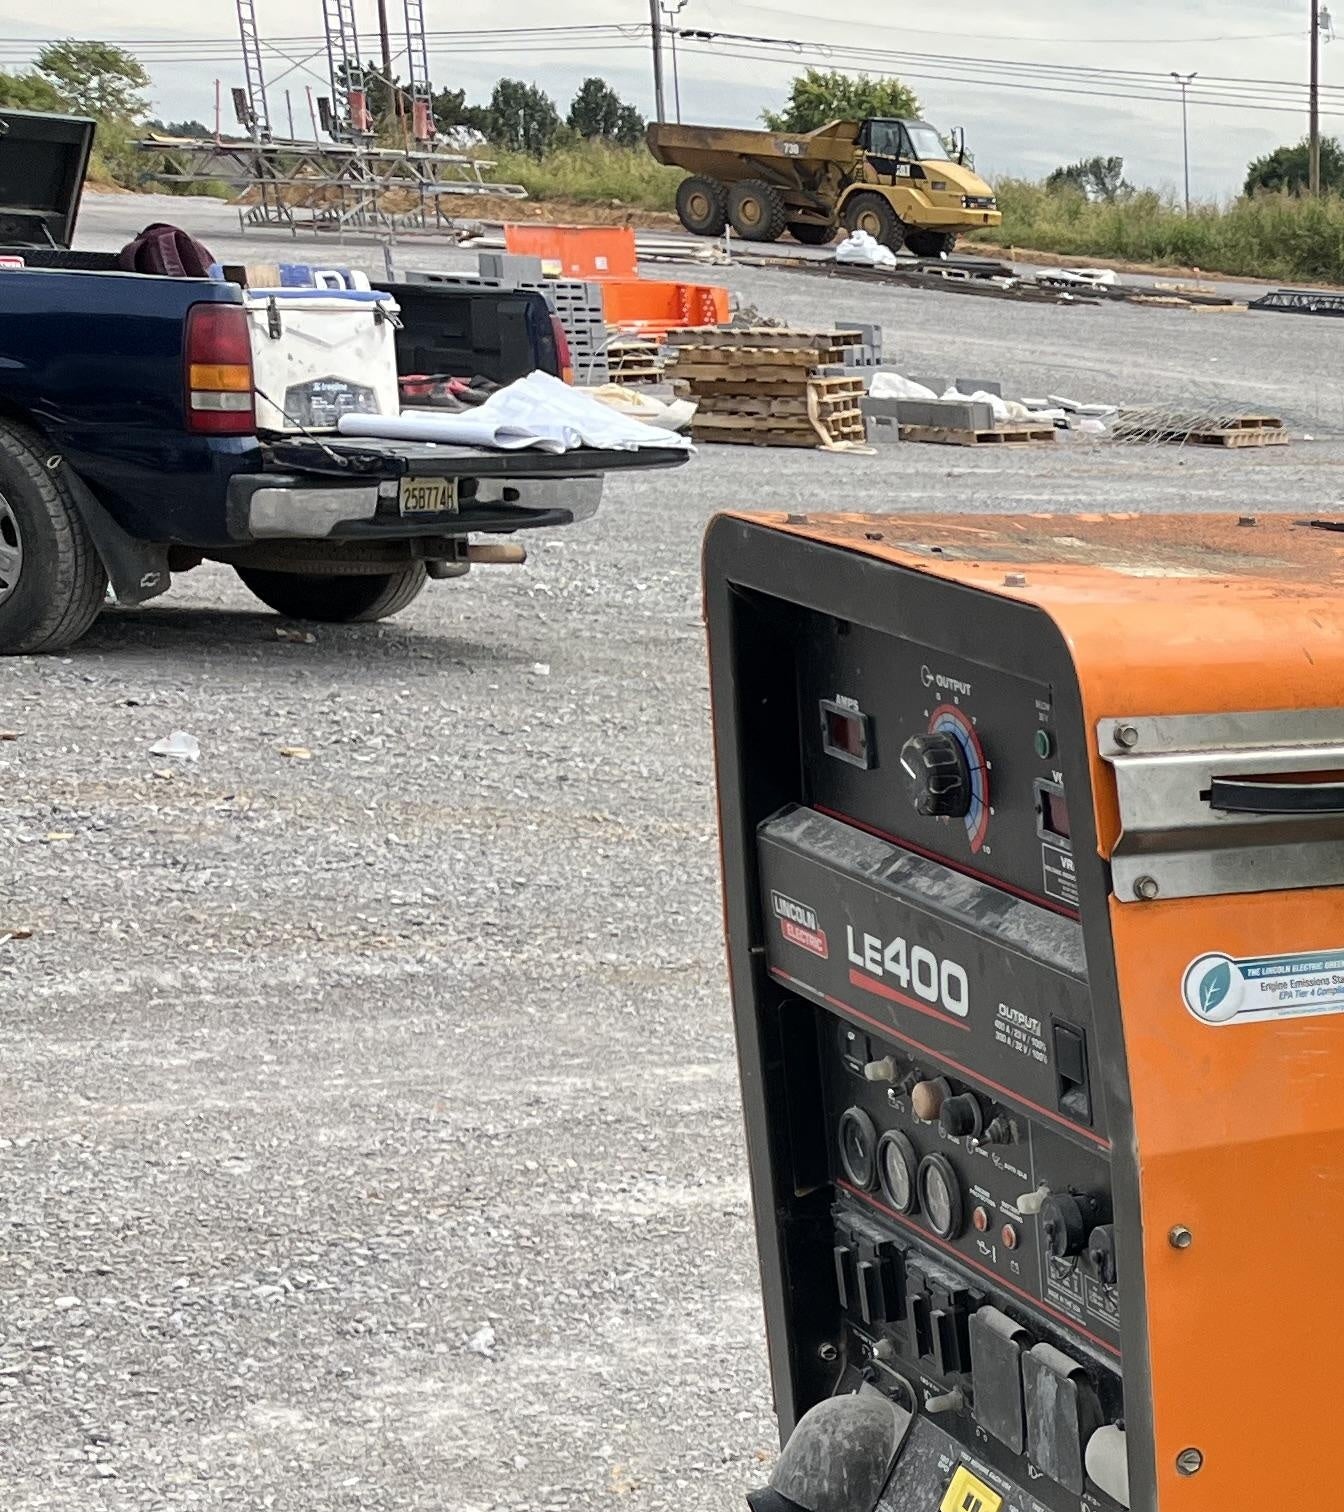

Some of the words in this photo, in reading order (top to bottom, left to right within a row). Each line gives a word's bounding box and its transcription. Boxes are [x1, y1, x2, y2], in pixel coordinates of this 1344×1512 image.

[936, 675, 972, 696] OUTPUT
[774, 895, 816, 930] LINCOLN
[787, 923, 823, 952] ELECTRIC
[846, 924, 969, 1017] LE400
[1247, 968, 1260, 977] THE
[1262, 965, 1291, 975] LINCOLN
[1292, 962, 1324, 973] ELECTRIC
[1260, 981, 1288, 992] Engine
[1290, 978, 1330, 989] Emissions
[1279, 990, 1292, 1000] EPA
[1295, 989, 1309, 999] Tier
[999, 1003, 1038, 1031] OUTPUT
